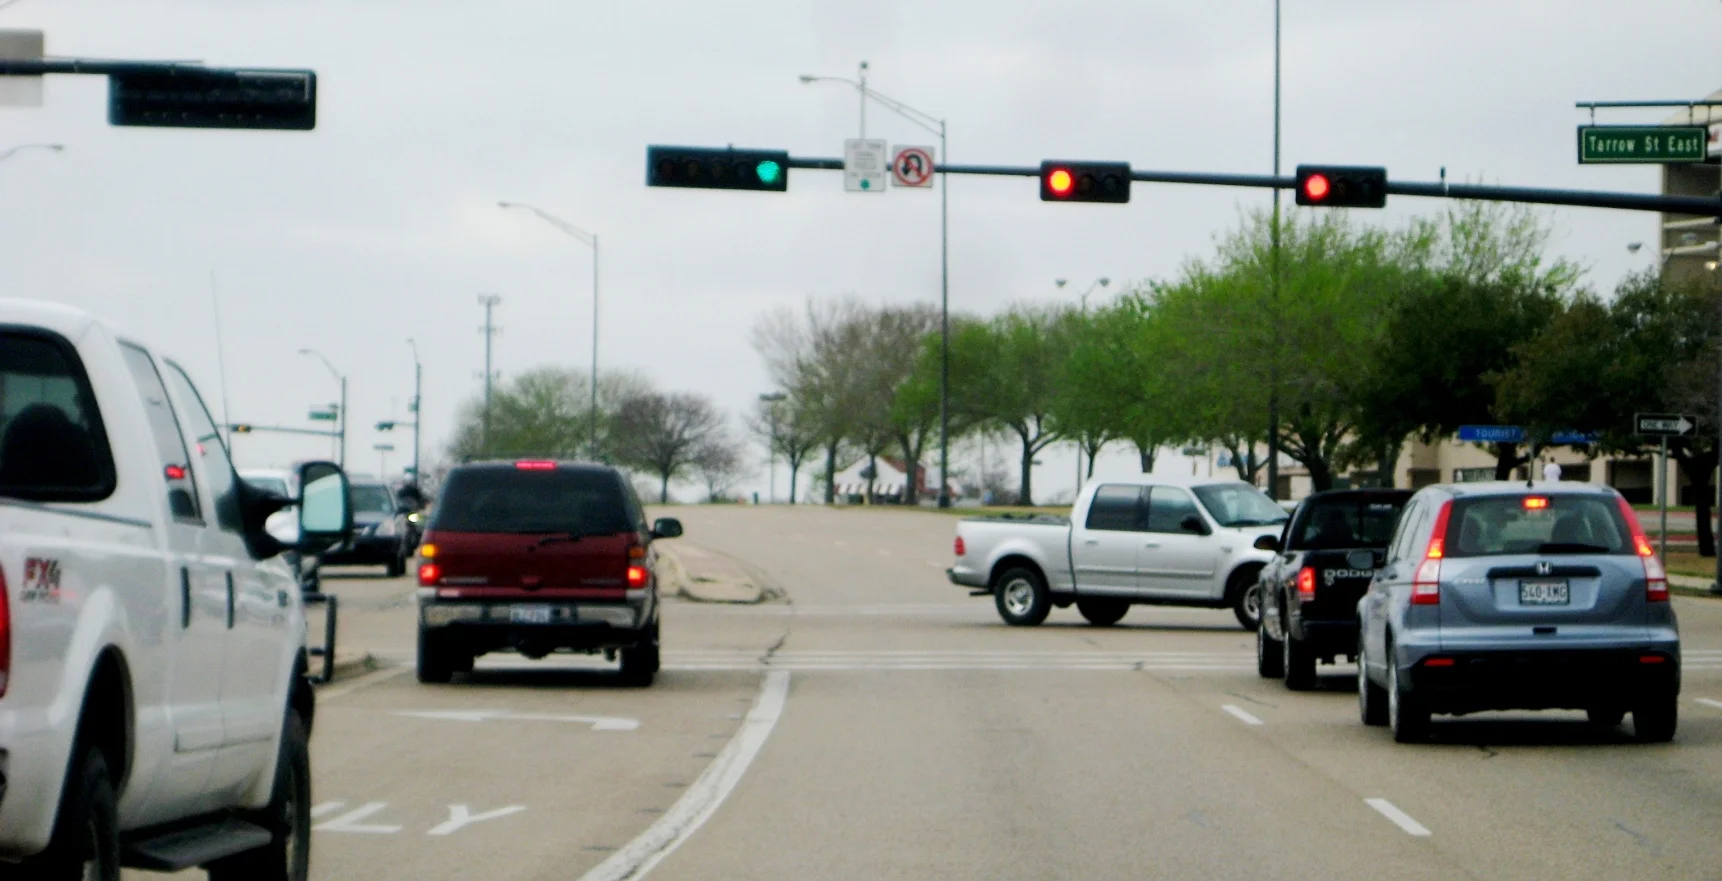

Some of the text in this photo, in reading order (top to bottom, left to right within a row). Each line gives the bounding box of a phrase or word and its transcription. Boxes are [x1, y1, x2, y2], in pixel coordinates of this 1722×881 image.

[1589, 135, 1699, 152] Tarrow St East
[23, 556, 62, 590] FX4
